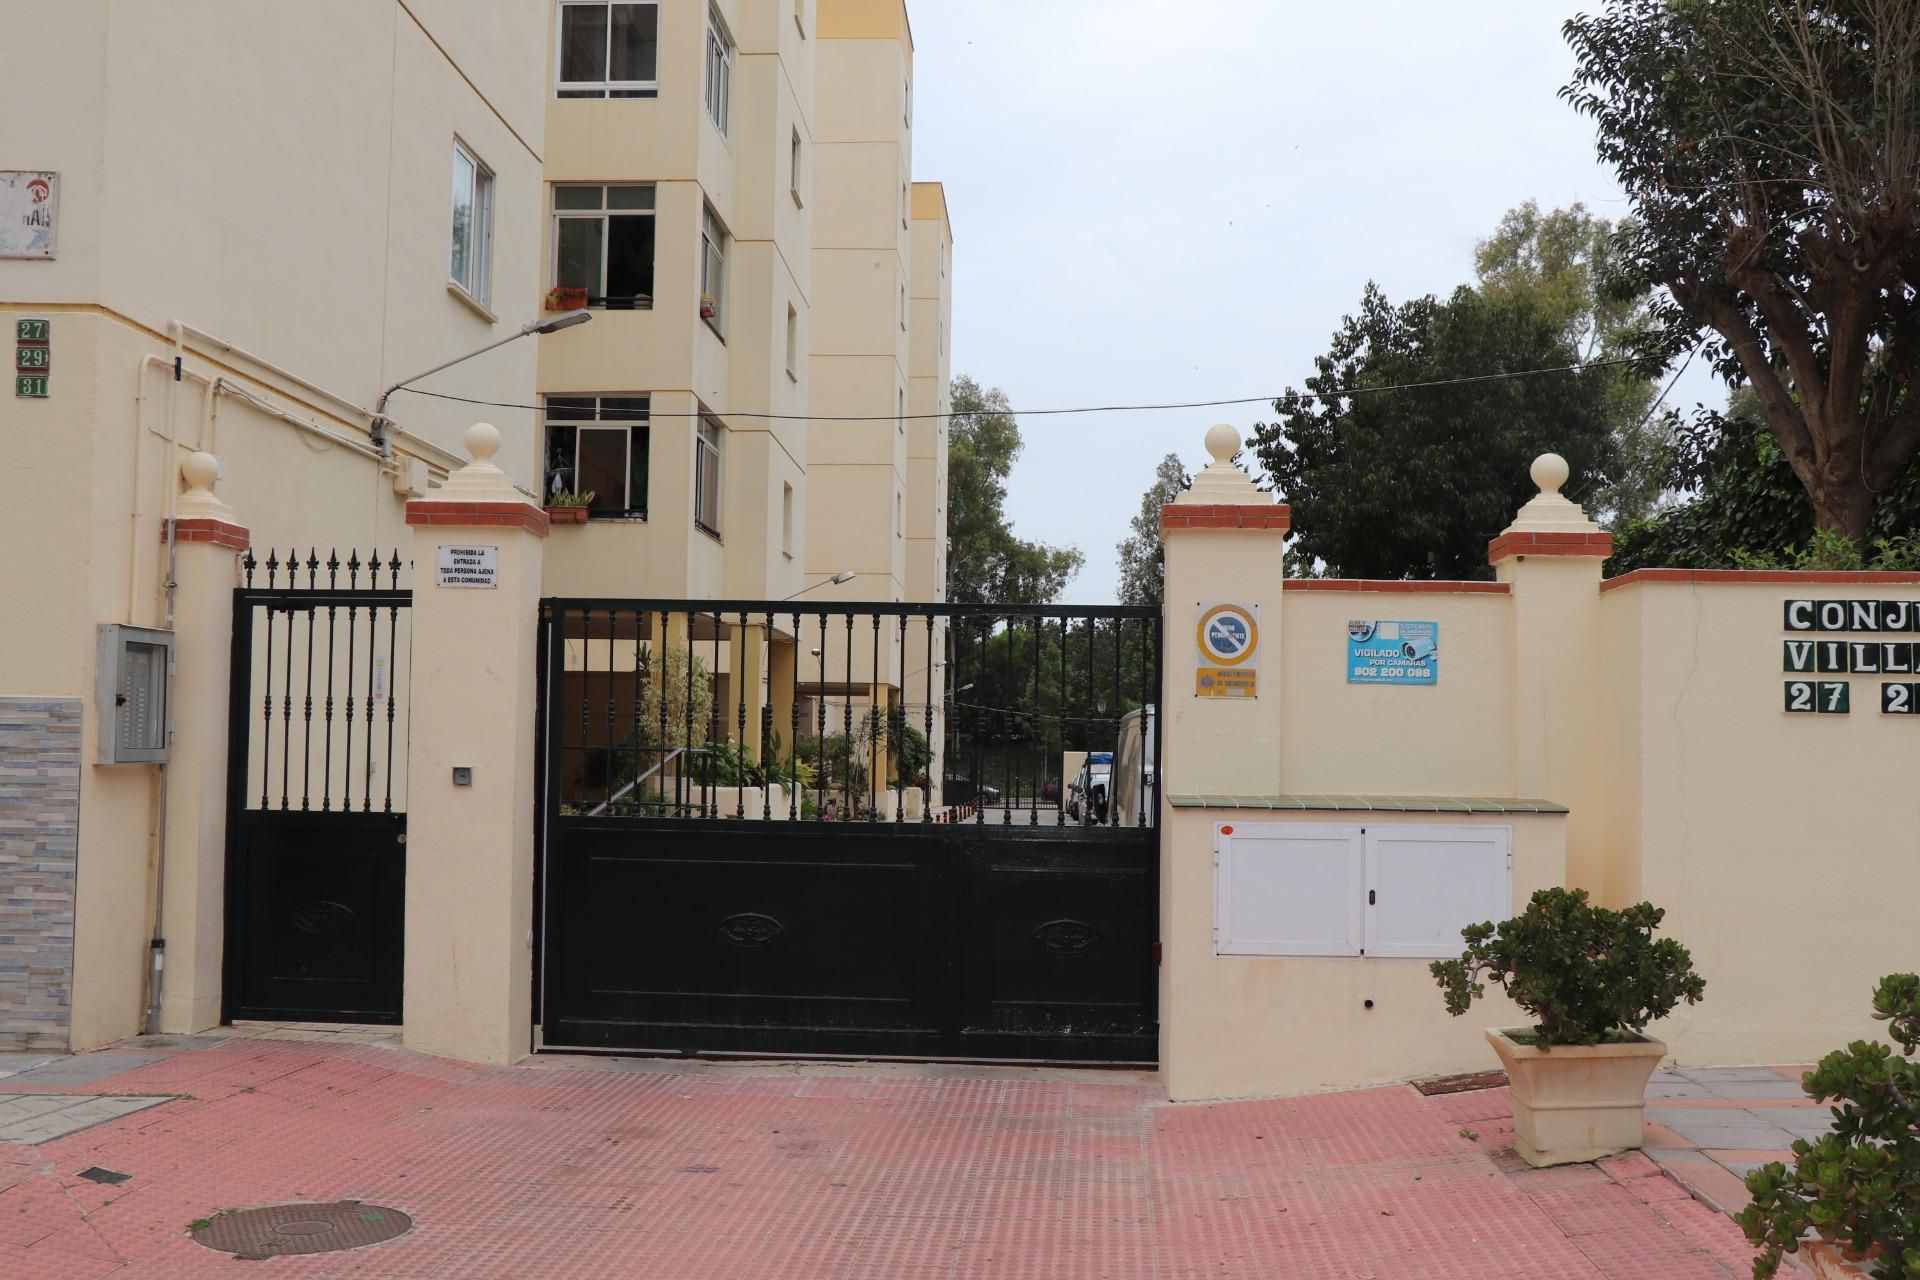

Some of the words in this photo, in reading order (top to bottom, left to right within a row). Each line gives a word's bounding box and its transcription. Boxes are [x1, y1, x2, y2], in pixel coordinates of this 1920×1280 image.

[21, 322, 43, 338] 27
[21, 350, 43, 366] 29
[23, 379, 42, 394] 31
[1789, 600, 1920, 630] CONJ
[1354, 649, 1400, 658] VIGILADO
[1786, 641, 1920, 673] VILL
[1354, 666, 1377, 677] 902
[1380, 667, 1404, 677] 200
[1790, 682, 1844, 711] 27
[1886, 684, 1910, 712] 2
